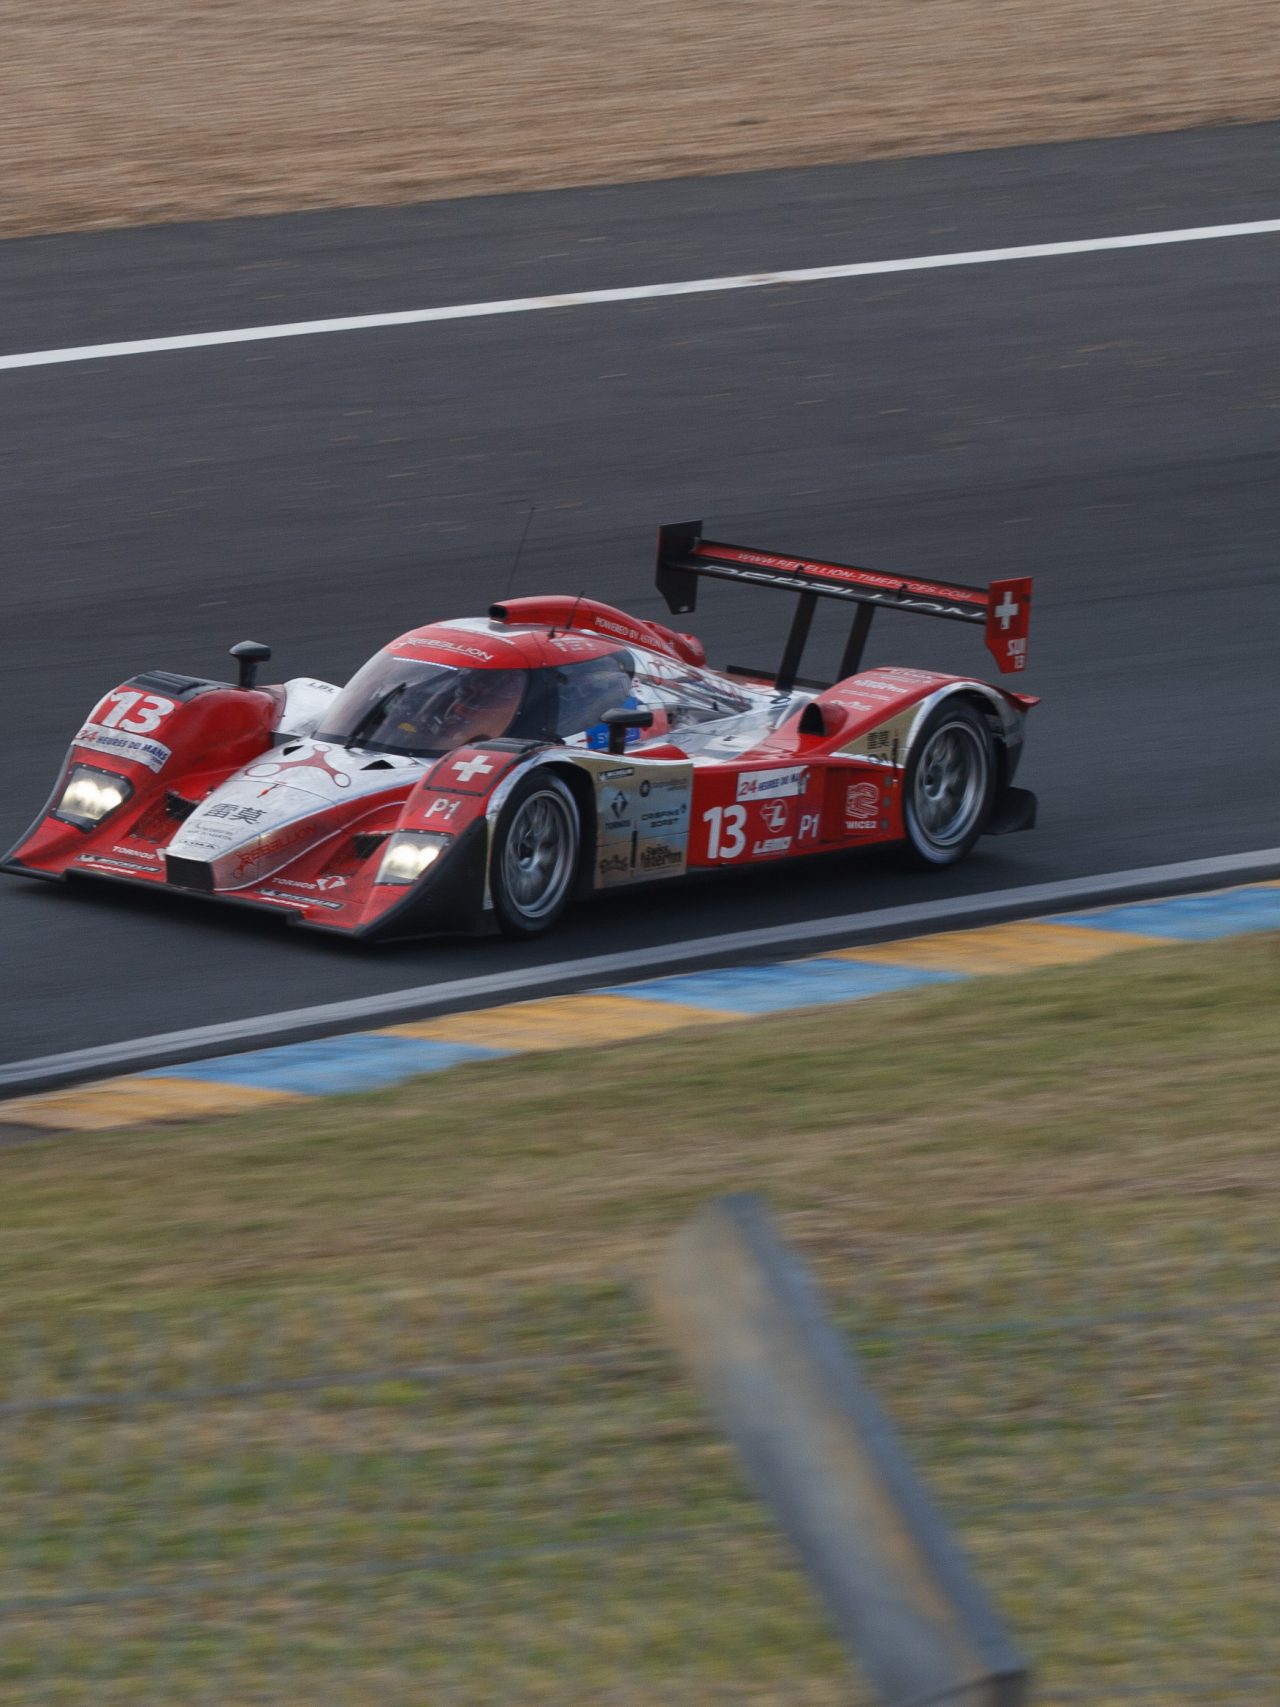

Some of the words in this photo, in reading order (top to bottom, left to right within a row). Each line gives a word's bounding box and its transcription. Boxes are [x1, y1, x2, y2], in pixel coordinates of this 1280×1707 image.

[102, 691, 175, 734] 13
[97, 735, 128, 750] HEURES
[128, 740, 141, 751] DU
[141, 743, 169, 762] MANS
[738, 779, 758, 797] 24
[424, 798, 462, 821] P1
[702, 804, 747, 860] 13
[798, 813, 820, 841] P1
[112, 845, 154, 860] TORNOS
[271, 877, 317, 890] TORNOS
